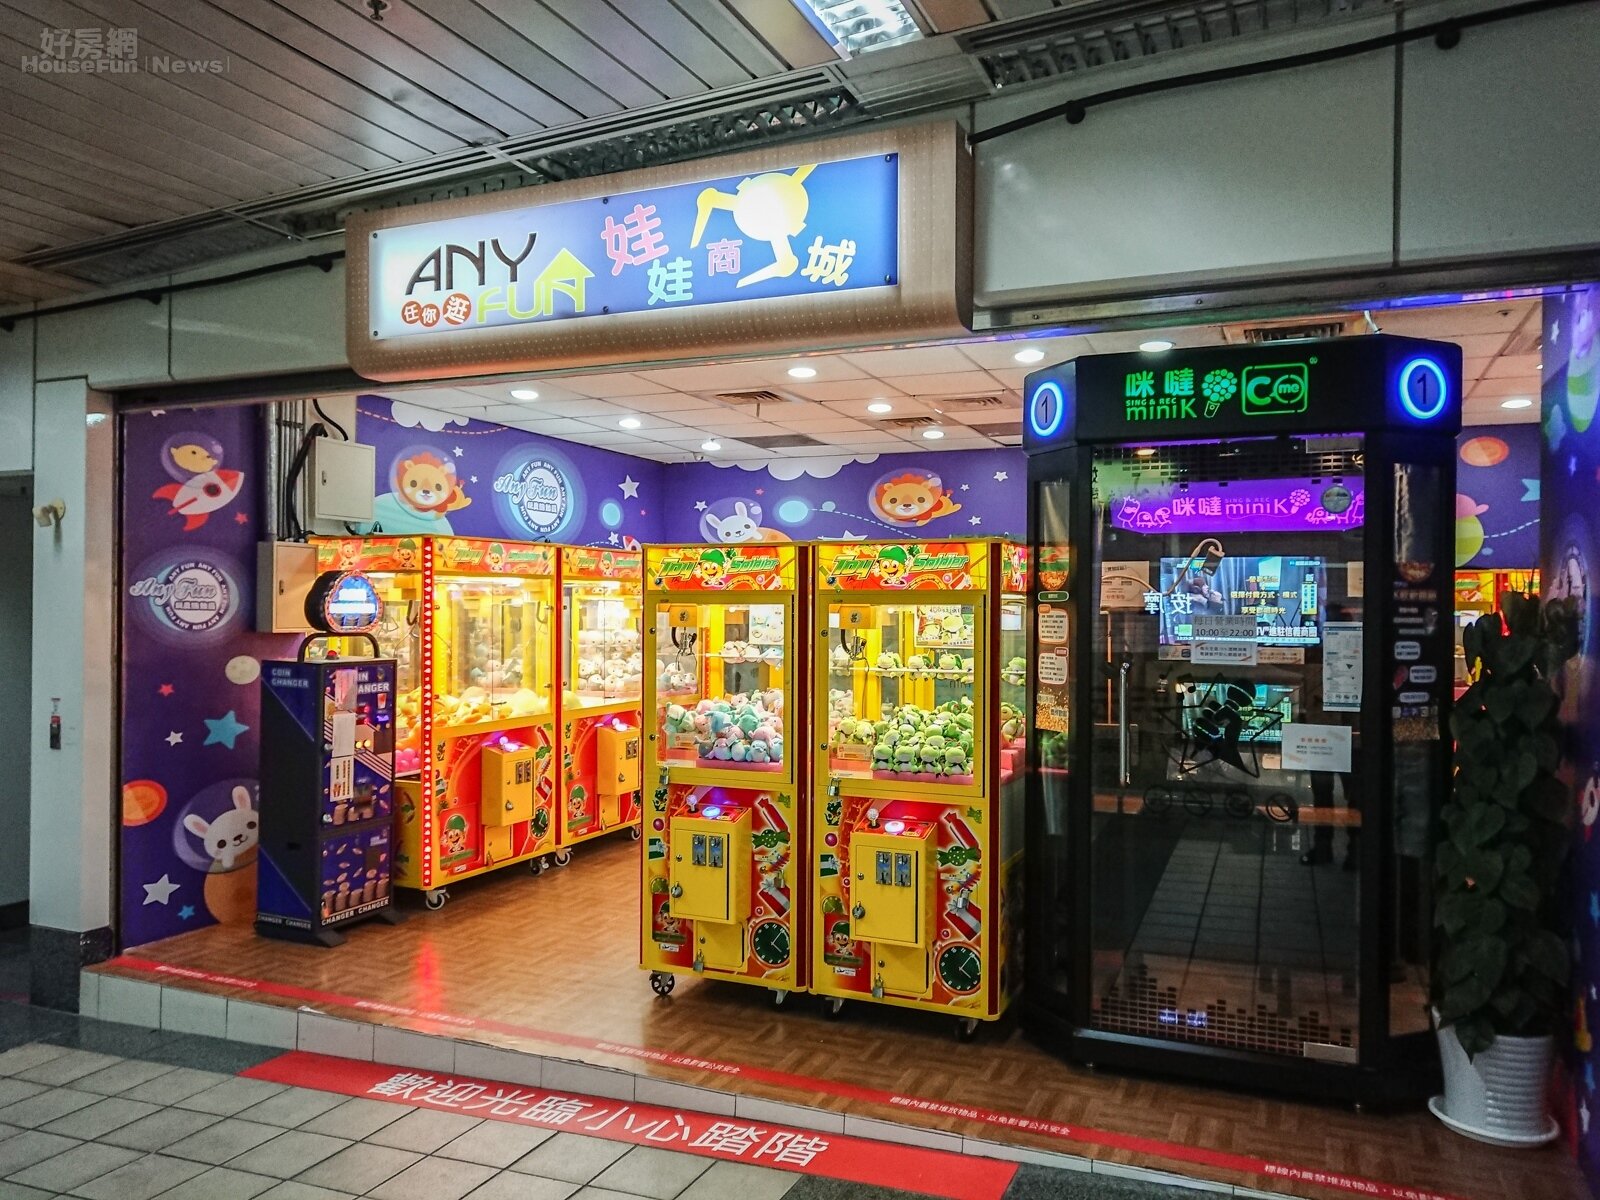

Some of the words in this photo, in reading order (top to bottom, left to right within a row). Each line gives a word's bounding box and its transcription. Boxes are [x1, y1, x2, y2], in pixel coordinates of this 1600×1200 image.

[404, 231, 538, 296] ANY
[601, 204, 856, 306] 娃娃商城
[476, 256, 592, 324] FUN
[402, 293, 472, 327] 任你逛
[1125, 367, 1195, 398] 咪噠
[1415, 373, 1431, 405] 1
[1039, 395, 1051, 424] 1
[1125, 398, 1147, 407] SING
[1159, 397, 1177, 405] REC
[494, 473, 528, 505] Any
[526, 476, 558, 501] Fun
[1172, 496, 1222, 517] 咪噠
[658, 558, 699, 581] Toy
[727, 556, 779, 573] Soldier
[832, 555, 877, 579] Toy
[911, 553, 971, 572] Soldier
[129, 577, 175, 607] Any
[174, 577, 218, 601] Fun
[271, 668, 292, 678] COIN
[271, 678, 310, 689] CHANGER
[357, 682, 391, 695] ANGER
[257, 913, 283, 925] CHANGER
[285, 917, 313, 930] CHANGER
[321, 909, 355, 926] CHANGER
[357, 898, 390, 915] CHANGER
[367, 1072, 831, 1168] 歡迎光臨小心踏階
